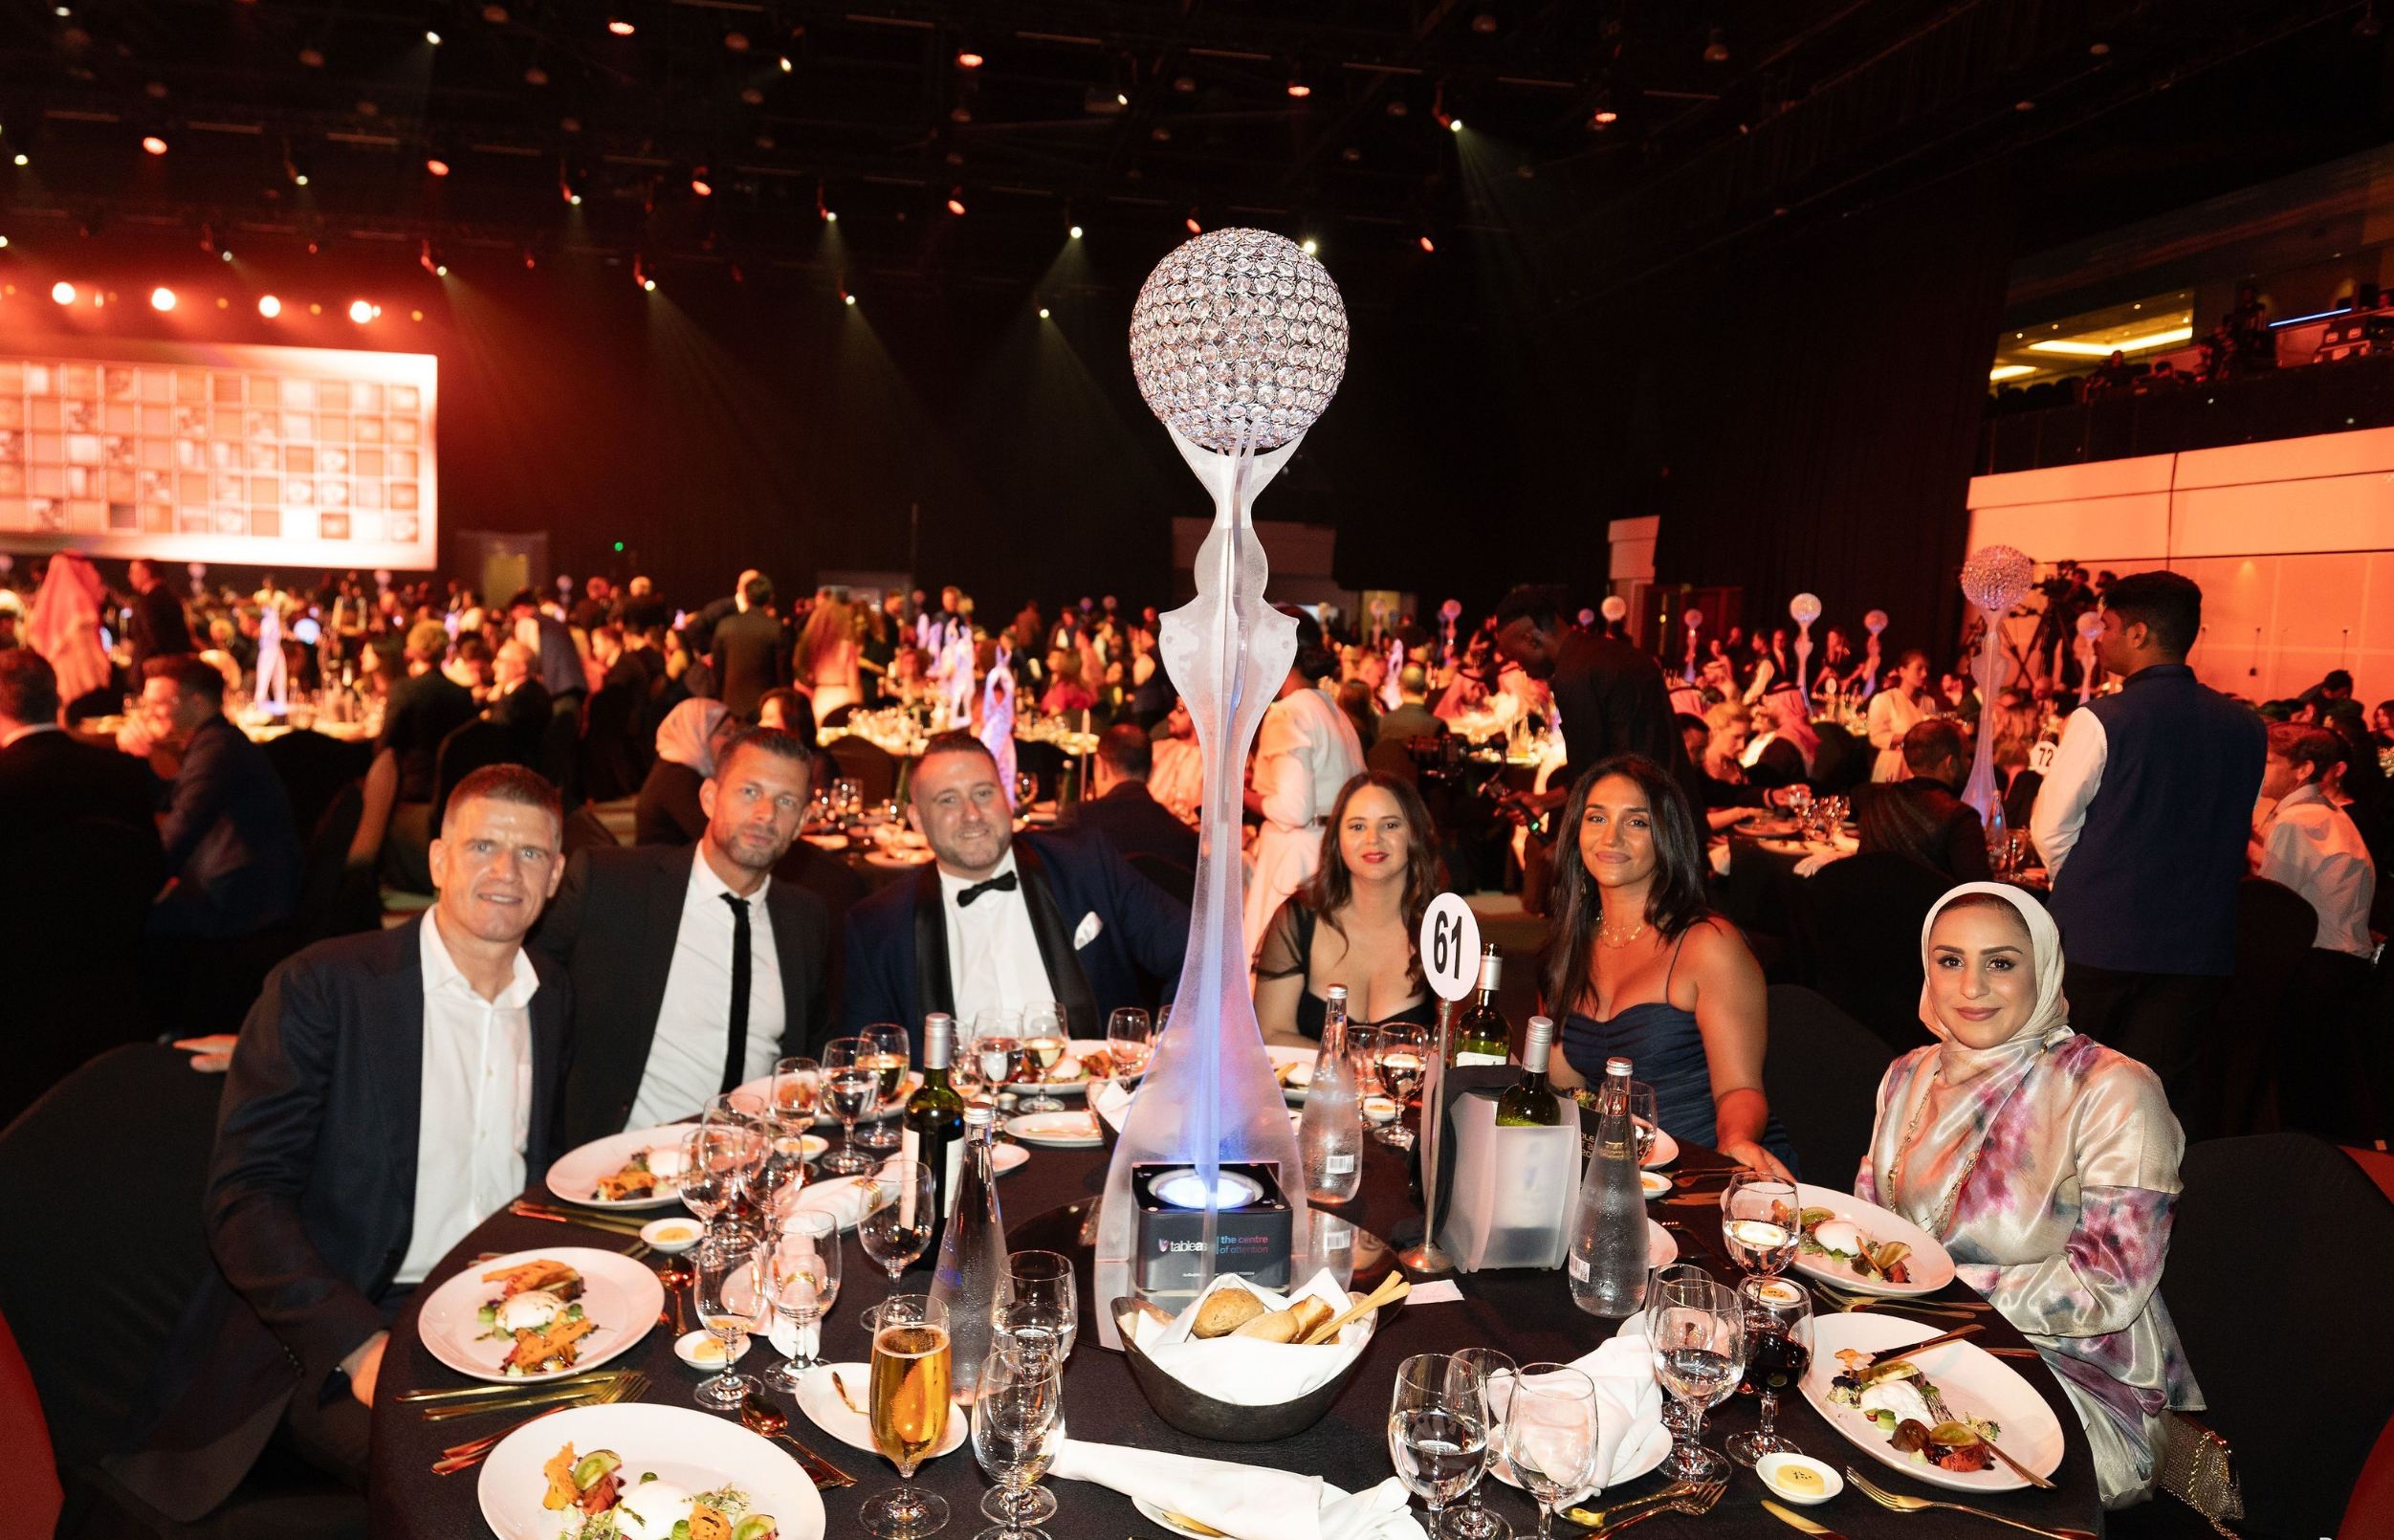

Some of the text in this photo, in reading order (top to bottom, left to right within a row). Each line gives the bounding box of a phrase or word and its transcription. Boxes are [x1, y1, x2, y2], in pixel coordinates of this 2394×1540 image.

[2039, 747, 2054, 767] 72
[1434, 911, 1462, 979] 61
[1220, 1235, 1269, 1243] the centre
[1219, 1245, 1229, 1254] of
